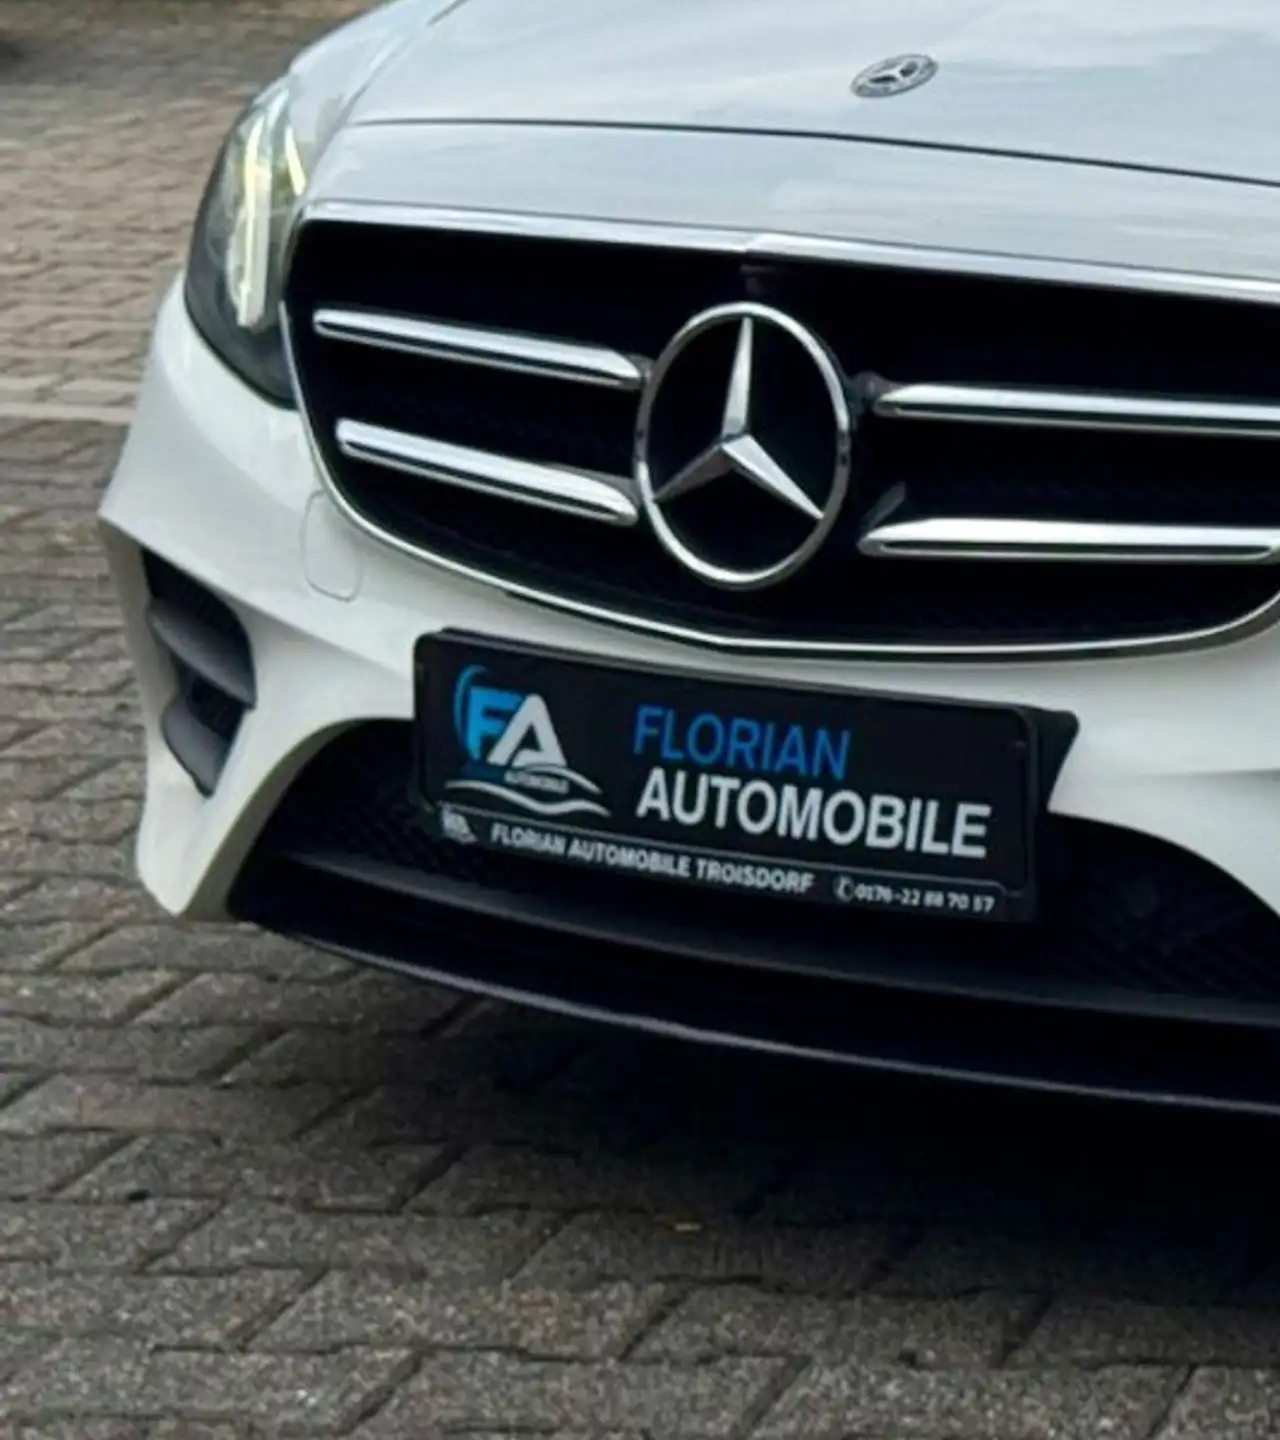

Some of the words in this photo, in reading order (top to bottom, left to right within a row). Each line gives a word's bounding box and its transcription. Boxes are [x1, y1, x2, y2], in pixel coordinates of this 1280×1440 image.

[466, 686, 568, 767] FA
[633, 705, 851, 780] FLORIAN
[636, 766, 992, 858] AUTOMOBILE
[490, 823, 568, 856] FLORIAN
[567, 838, 692, 879] AUTOMOBILE
[696, 859, 814, 894] TROISDORF
